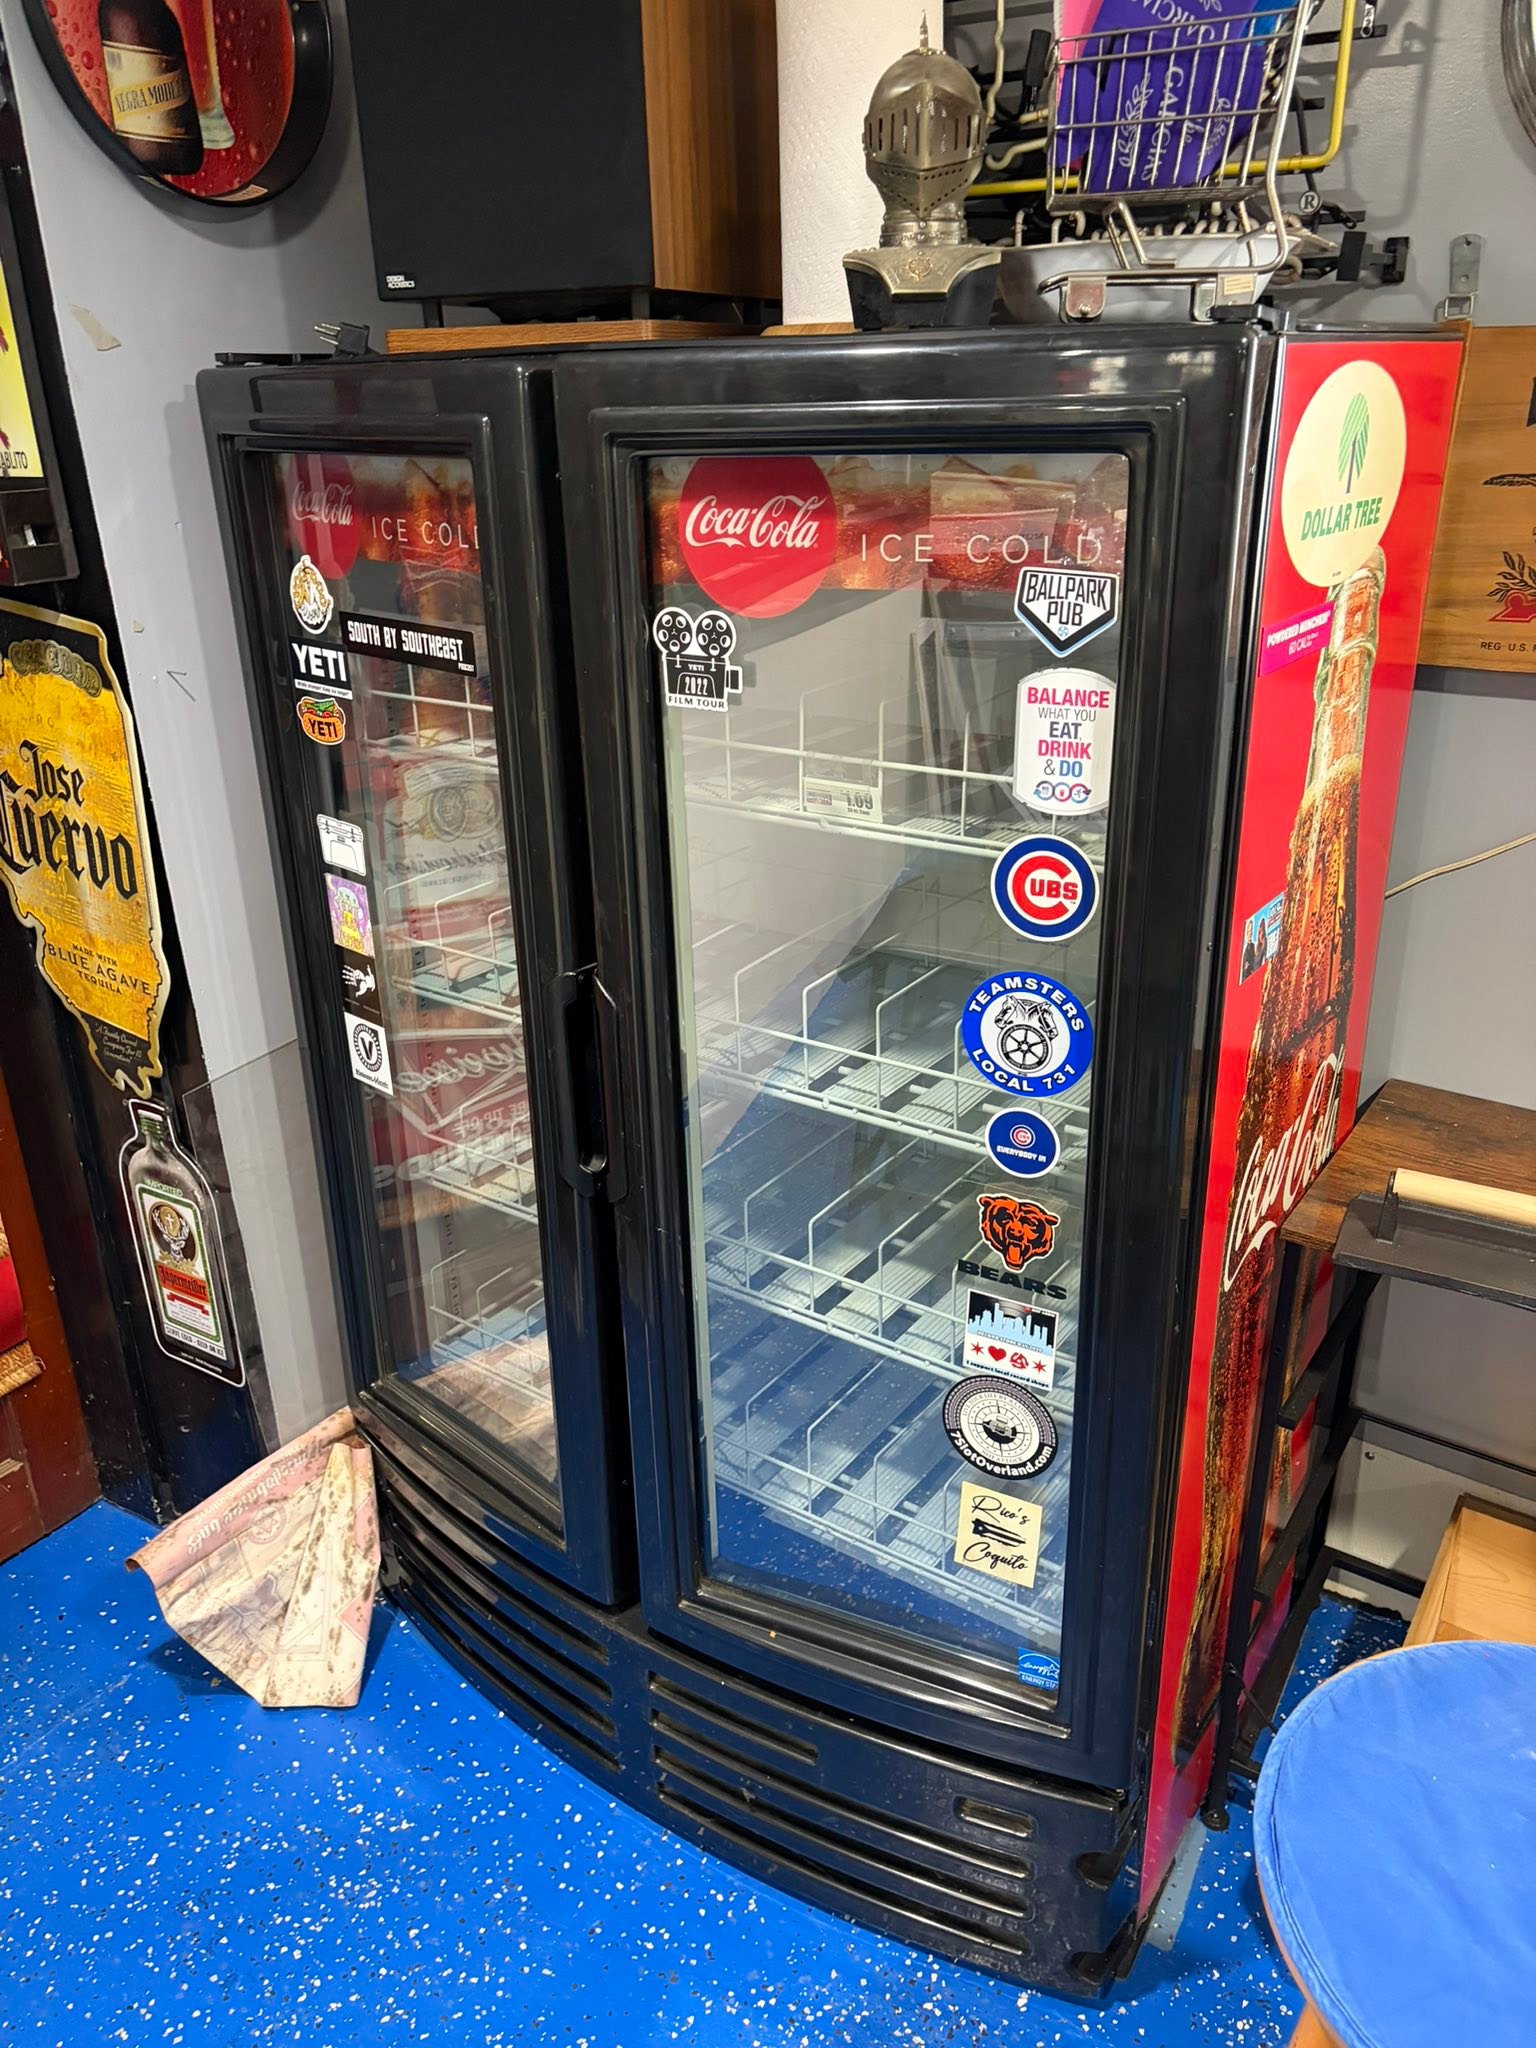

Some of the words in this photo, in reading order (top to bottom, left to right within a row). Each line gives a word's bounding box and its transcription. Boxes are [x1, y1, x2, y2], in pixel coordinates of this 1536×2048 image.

[115, 87, 146, 113] NEGRA
[371, 516, 409, 543] ICE
[685, 495, 829, 549] Coca-Cola
[1300, 502, 1352, 541] DOLLAR
[1356, 496, 1382, 527] TREE
[861, 533, 935, 564] ICE
[966, 533, 1102, 565] COLD
[1026, 572, 1108, 611] BALLPARK
[1046, 601, 1082, 627] PUB
[347, 620, 380, 646] SOUTH
[384, 628, 398, 649] BY
[1480, 641, 1501, 651] REG
[1508, 642, 1529, 652] U.S.
[291, 642, 347, 682] YETI
[688, 664, 704, 672] YETI
[684, 676, 709, 696] 2022
[1027, 686, 1110, 708] BALANCE
[668, 695, 694, 706] FILM
[696, 698, 725, 709] TOUR
[1038, 707, 1070, 720] WHAT
[1074, 708, 1096, 722] YOU
[308, 718, 338, 738] YETI
[1038, 739, 1092, 760] DRINK
[19, 738, 85, 807] Jose
[1044, 759, 1055, 776] &
[1059, 760, 1083, 777] DO
[1012, 855, 1079, 921] CUBS
[72, 943, 94, 957] MADE
[96, 953, 118, 966] WITH
[47, 943, 90, 970] BLUE
[96, 963, 152, 995] AGAVE
[77, 969, 123, 995] TEQUILA
[969, 976, 1085, 1031] TEAMSTERS
[972, 1048, 1034, 1092] LOCAL
[1042, 1064, 1076, 1090] 731
[996, 1145, 1038, 1161] EVERYBODY
[1037, 1154, 1047, 1163] IN
[1223, 1043, 1346, 1293] Coca-Cola
[144, 1179, 183, 1197] IMPORTED
[957, 1258, 1068, 1301] BEARS
[970, 1361, 994, 1373] support
[994, 1365, 1010, 1376] local
[1010, 1371, 1030, 1382] record
[1031, 1377, 1049, 1389] shops
[950, 1430, 1053, 1477] 7SlotOverland.com
[971, 1494, 1031, 1525] Rico's
[963, 1541, 1029, 1570] Coquito
